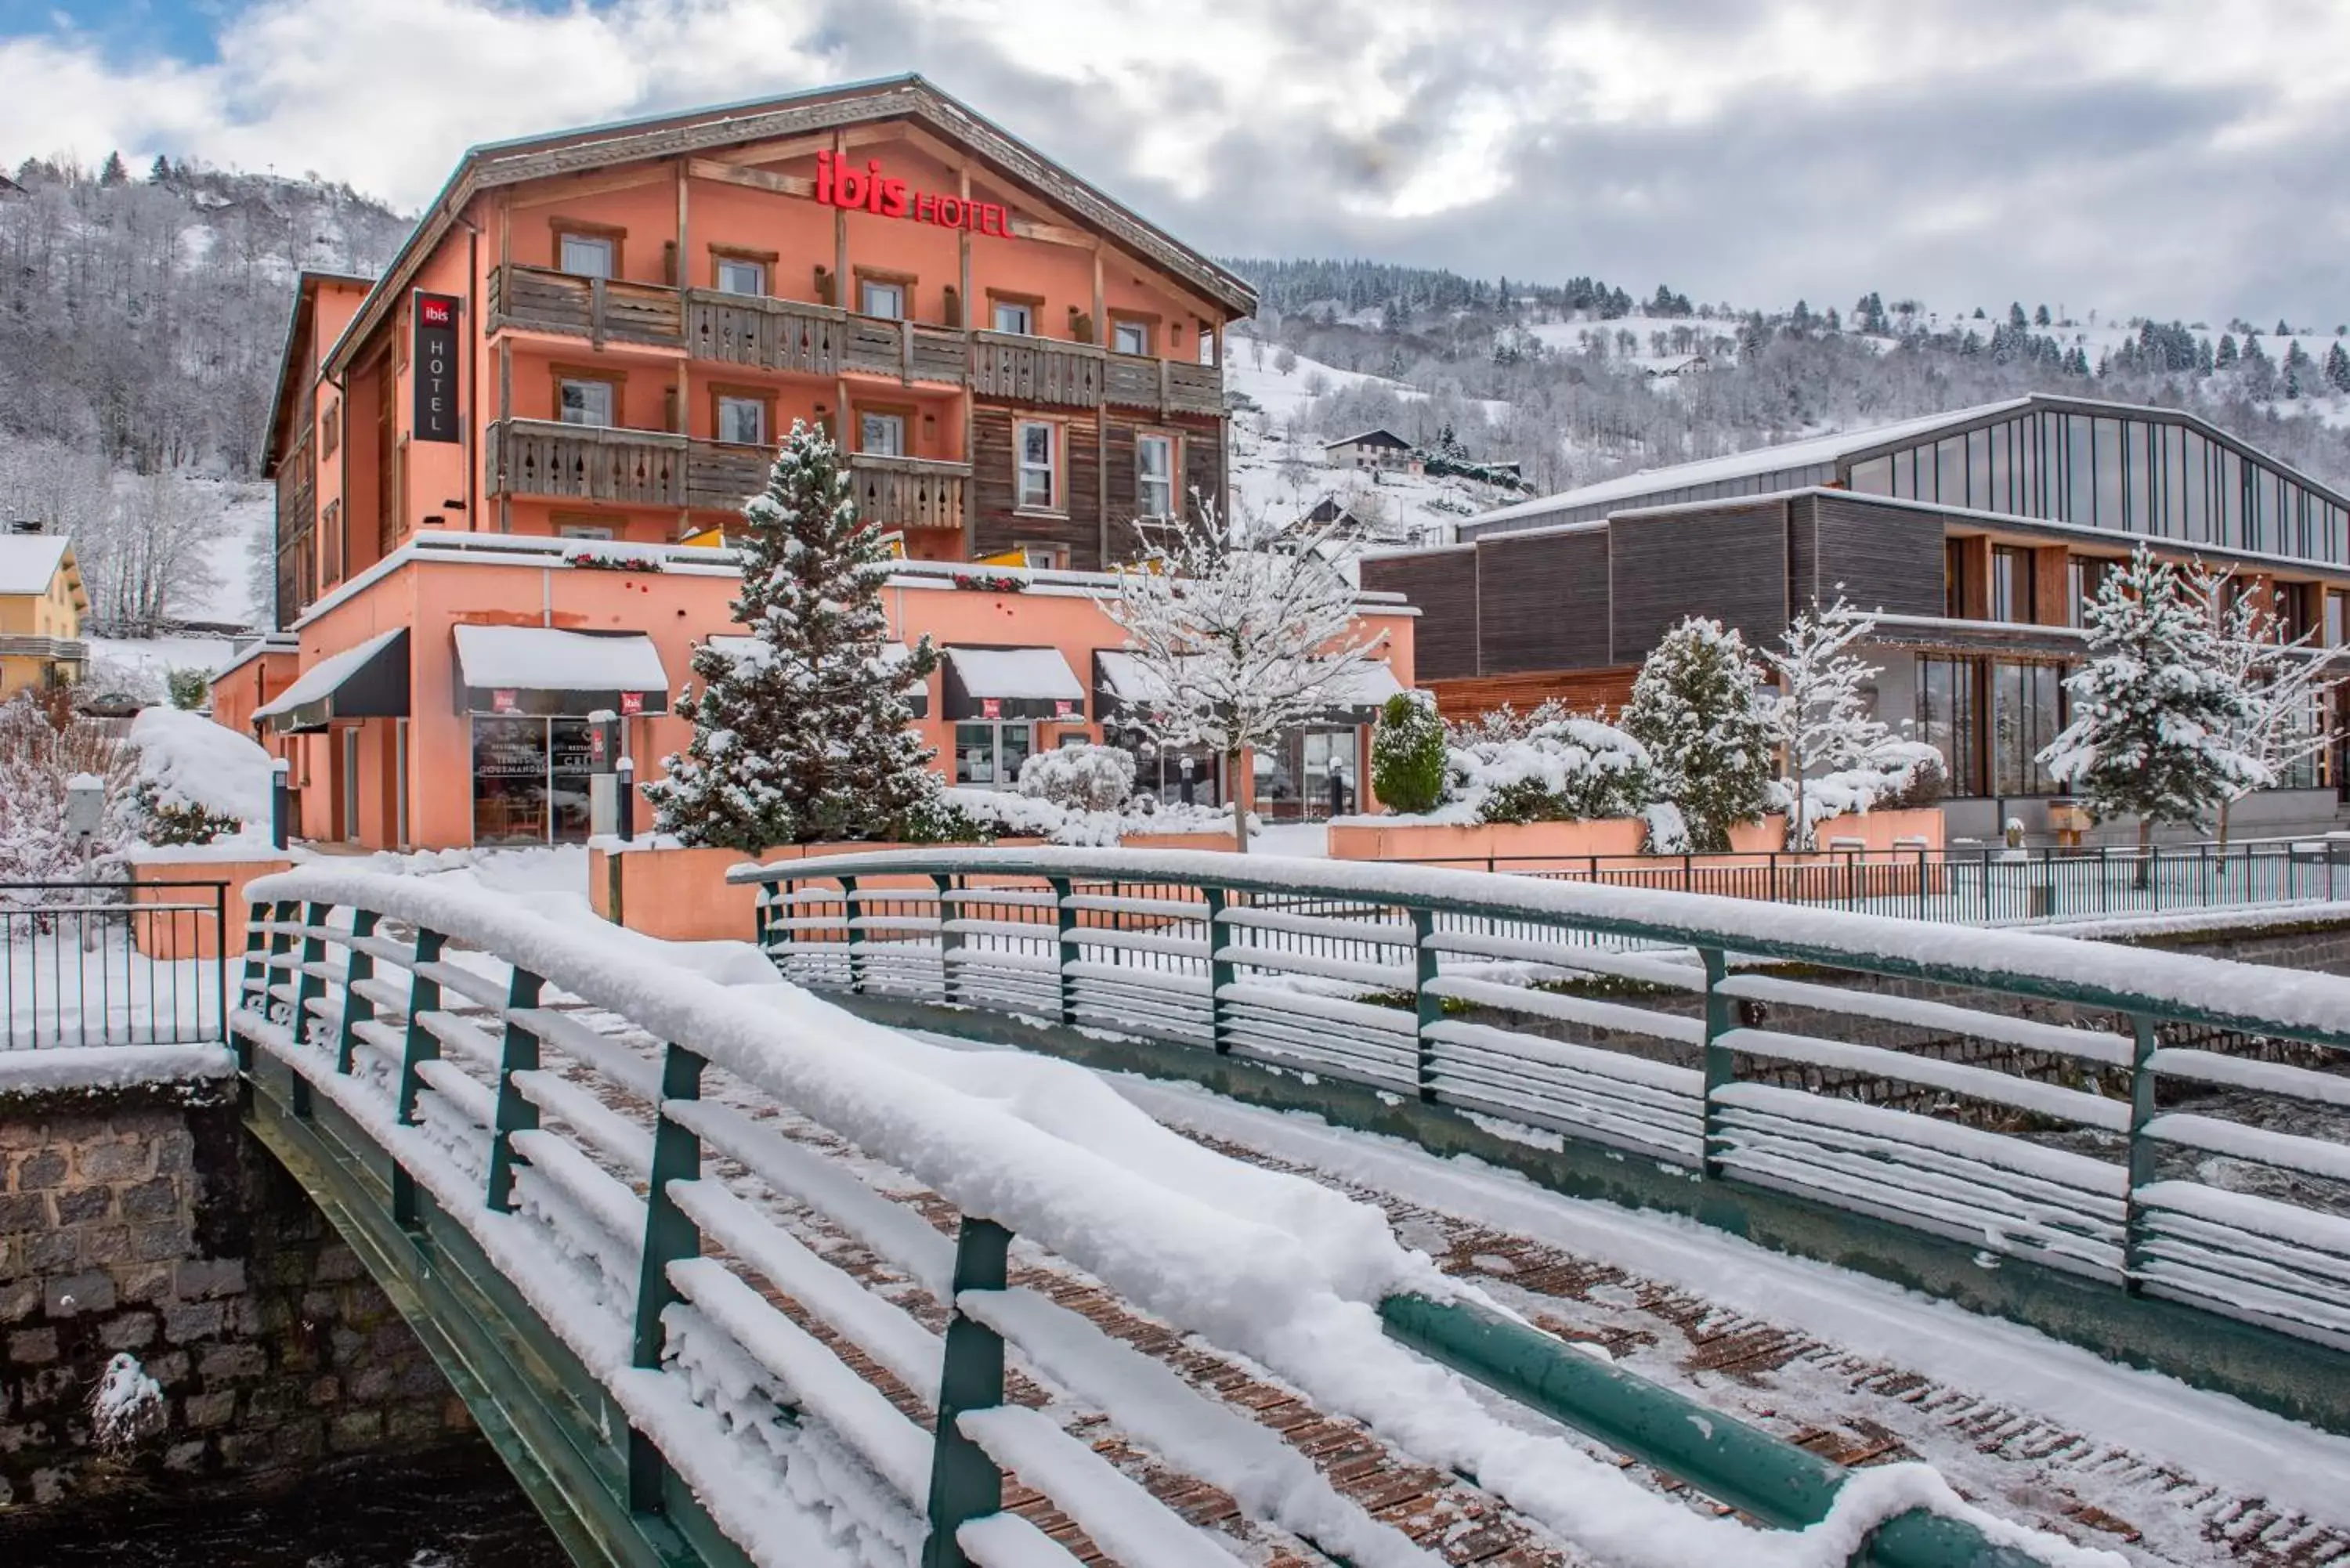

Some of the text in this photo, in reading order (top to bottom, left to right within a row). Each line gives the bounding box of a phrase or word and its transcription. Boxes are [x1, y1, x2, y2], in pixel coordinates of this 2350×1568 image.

[815, 150, 1015, 240] ibis HOTEL
[425, 306, 449, 322] ibis
[430, 341, 444, 431] HOTEL
